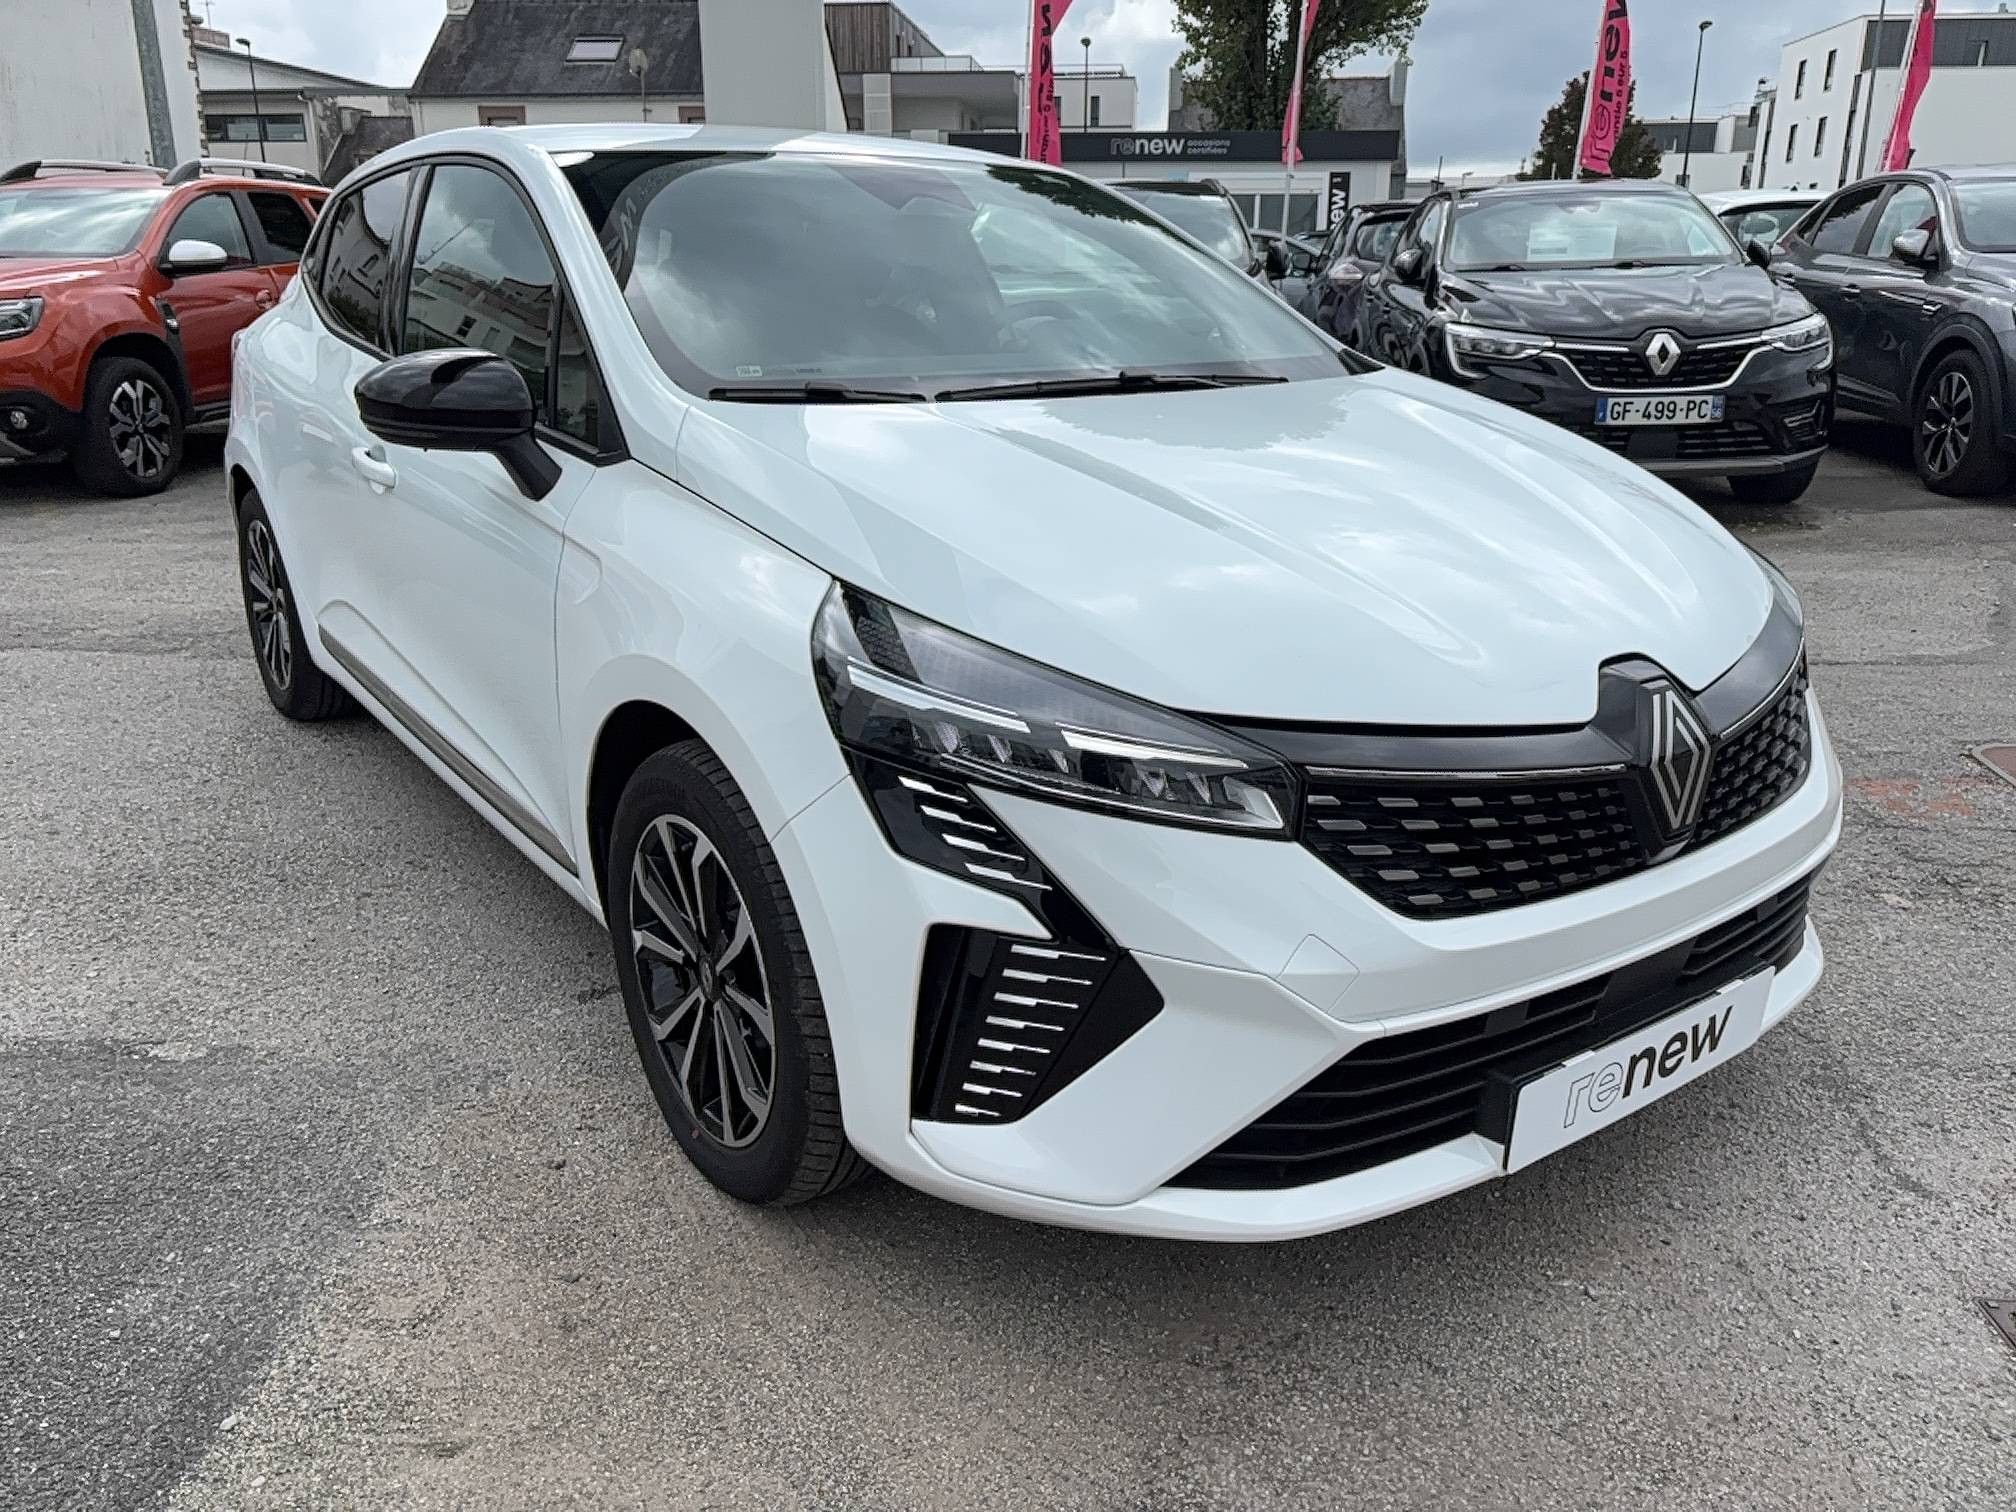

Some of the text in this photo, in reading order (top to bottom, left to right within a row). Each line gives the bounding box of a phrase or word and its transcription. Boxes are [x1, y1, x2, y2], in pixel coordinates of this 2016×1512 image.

[1110, 137, 1185, 155] renew
[1610, 400, 1709, 421] GF-499-PC
[1563, 1004, 1735, 1129] renew
